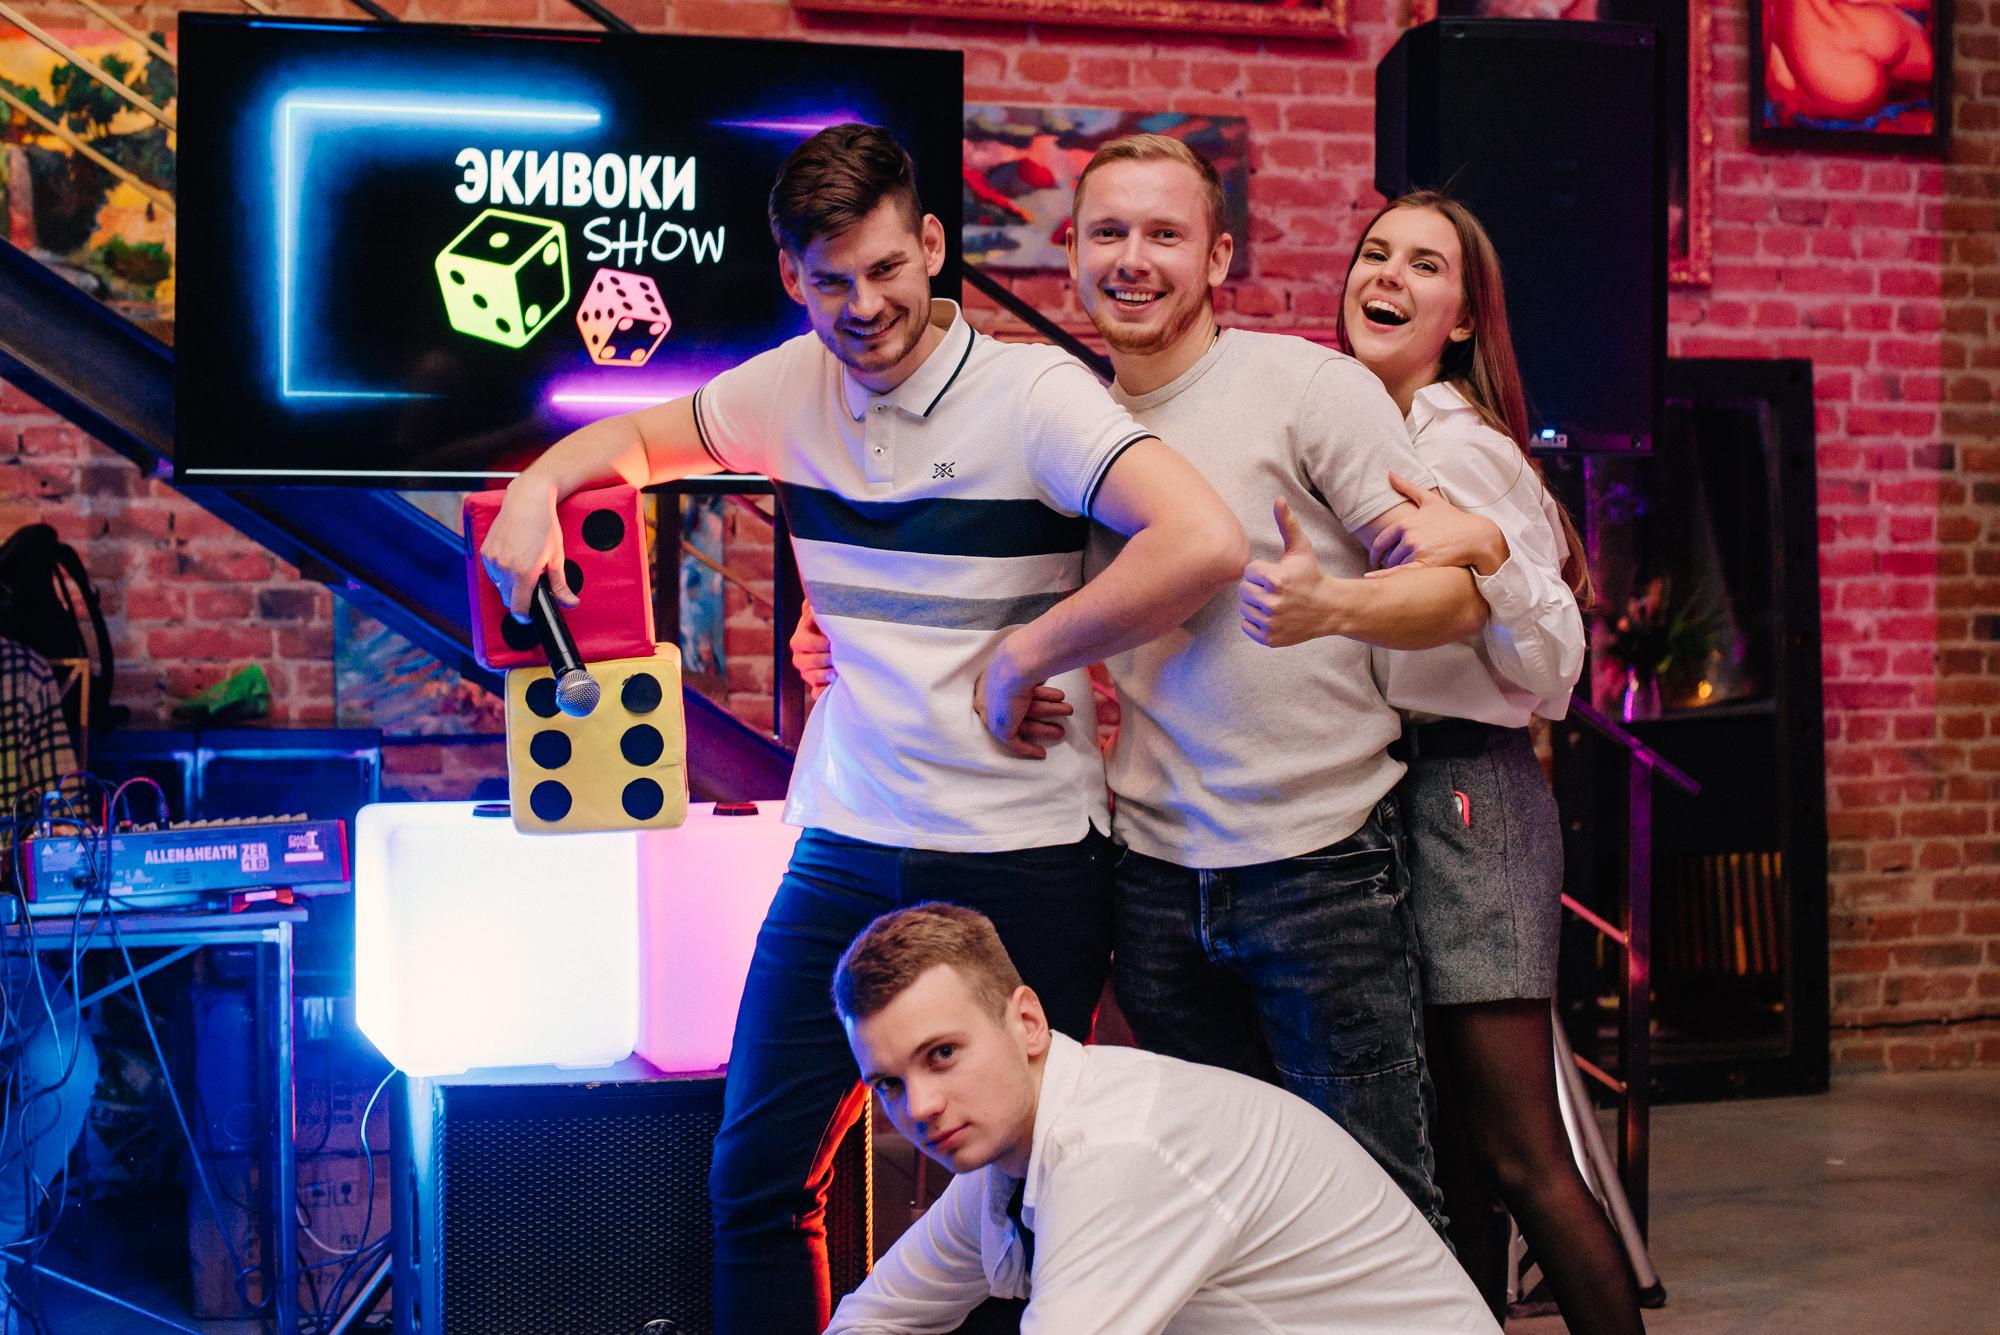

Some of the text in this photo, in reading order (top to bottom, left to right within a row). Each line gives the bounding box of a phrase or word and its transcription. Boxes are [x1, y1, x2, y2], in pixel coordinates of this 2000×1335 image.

[455, 147, 696, 210] ЭКИВОКИ
[583, 211, 725, 267] SHOW
[145, 845, 237, 864] ALLEN&HEATH
[241, 843, 267, 857] ZED
